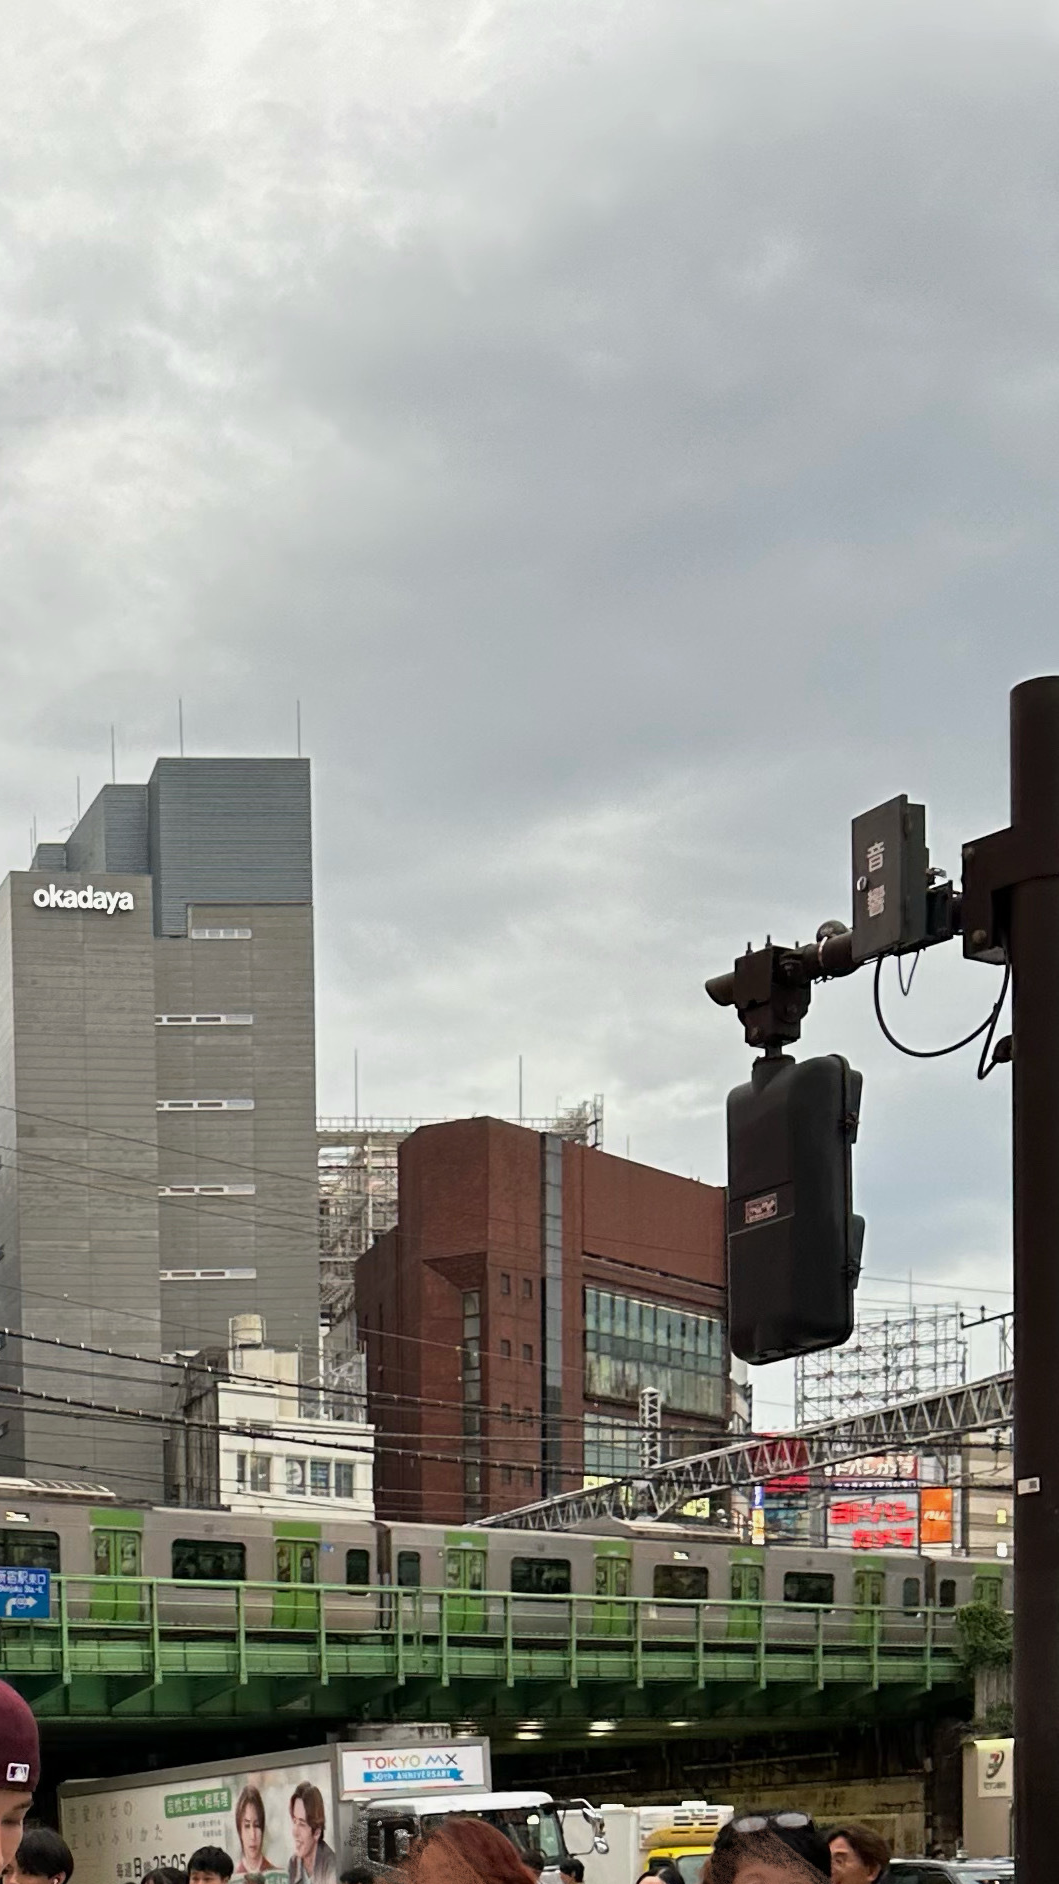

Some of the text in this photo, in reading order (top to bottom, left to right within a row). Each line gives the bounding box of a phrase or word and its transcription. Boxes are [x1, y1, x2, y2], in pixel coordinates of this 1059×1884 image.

[33, 883, 134, 915] okadaya
[852, 1528, 915, 1548] カメラ
[362, 1753, 458, 1770] TOKYO MX
[396, 1769, 451, 1780] ANNIVERSARY
